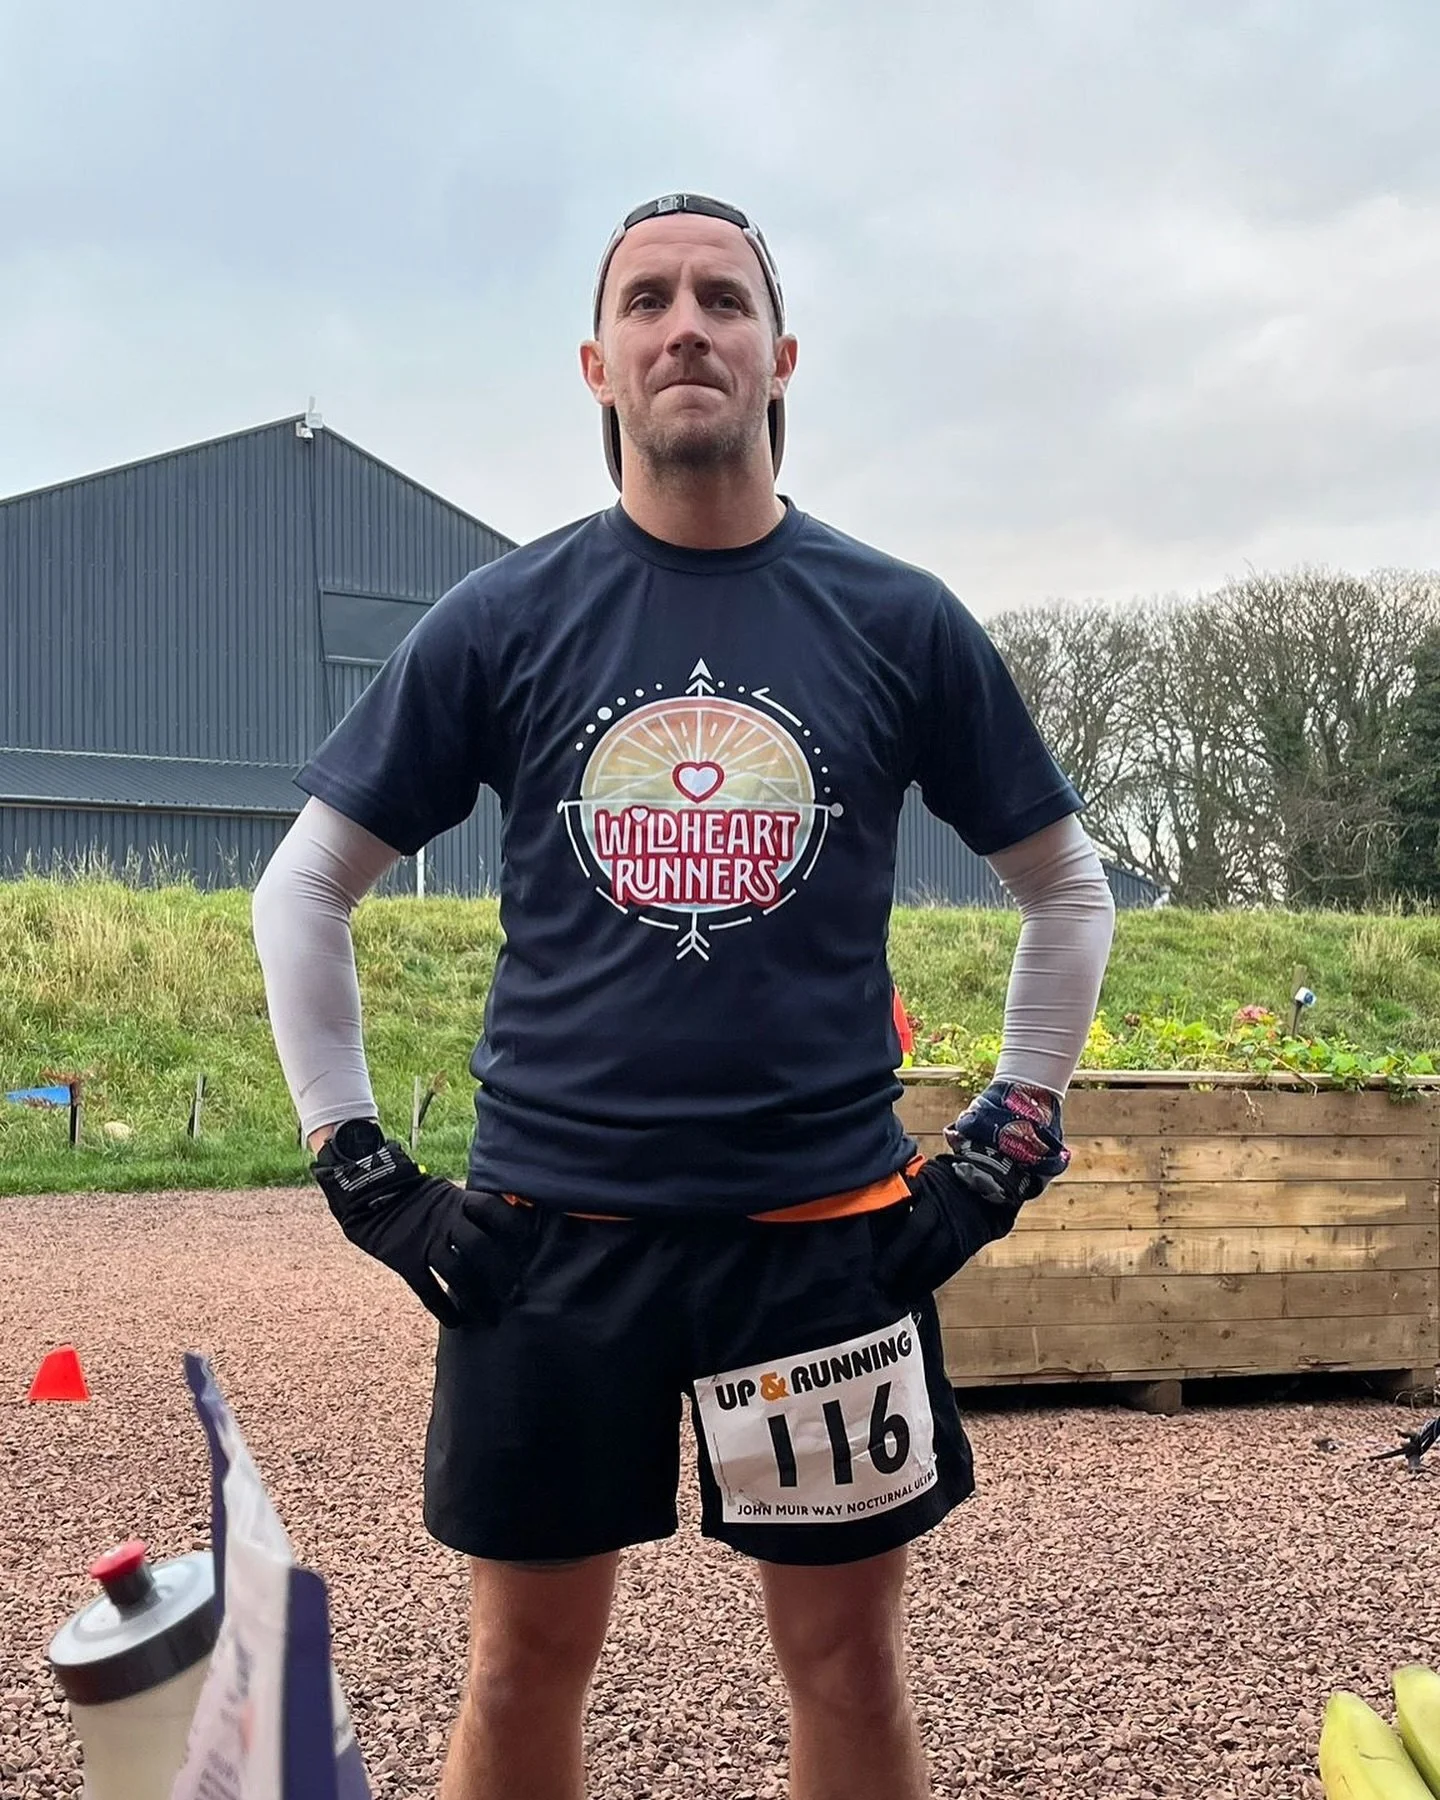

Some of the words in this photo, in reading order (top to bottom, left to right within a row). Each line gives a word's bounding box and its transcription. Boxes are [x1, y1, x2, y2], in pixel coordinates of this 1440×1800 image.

[615, 857, 777, 902] RUNNERS
[714, 1378, 756, 1410] UP
[760, 1371, 790, 1401] &
[790, 1330, 912, 1394] RUNNING
[767, 1381, 910, 1488] 116
[737, 1504, 772, 1516] JOHN
[775, 1504, 809, 1516] MUIR
[812, 1504, 843, 1516] WAY
[846, 1484, 914, 1514] NOCTURNAL
